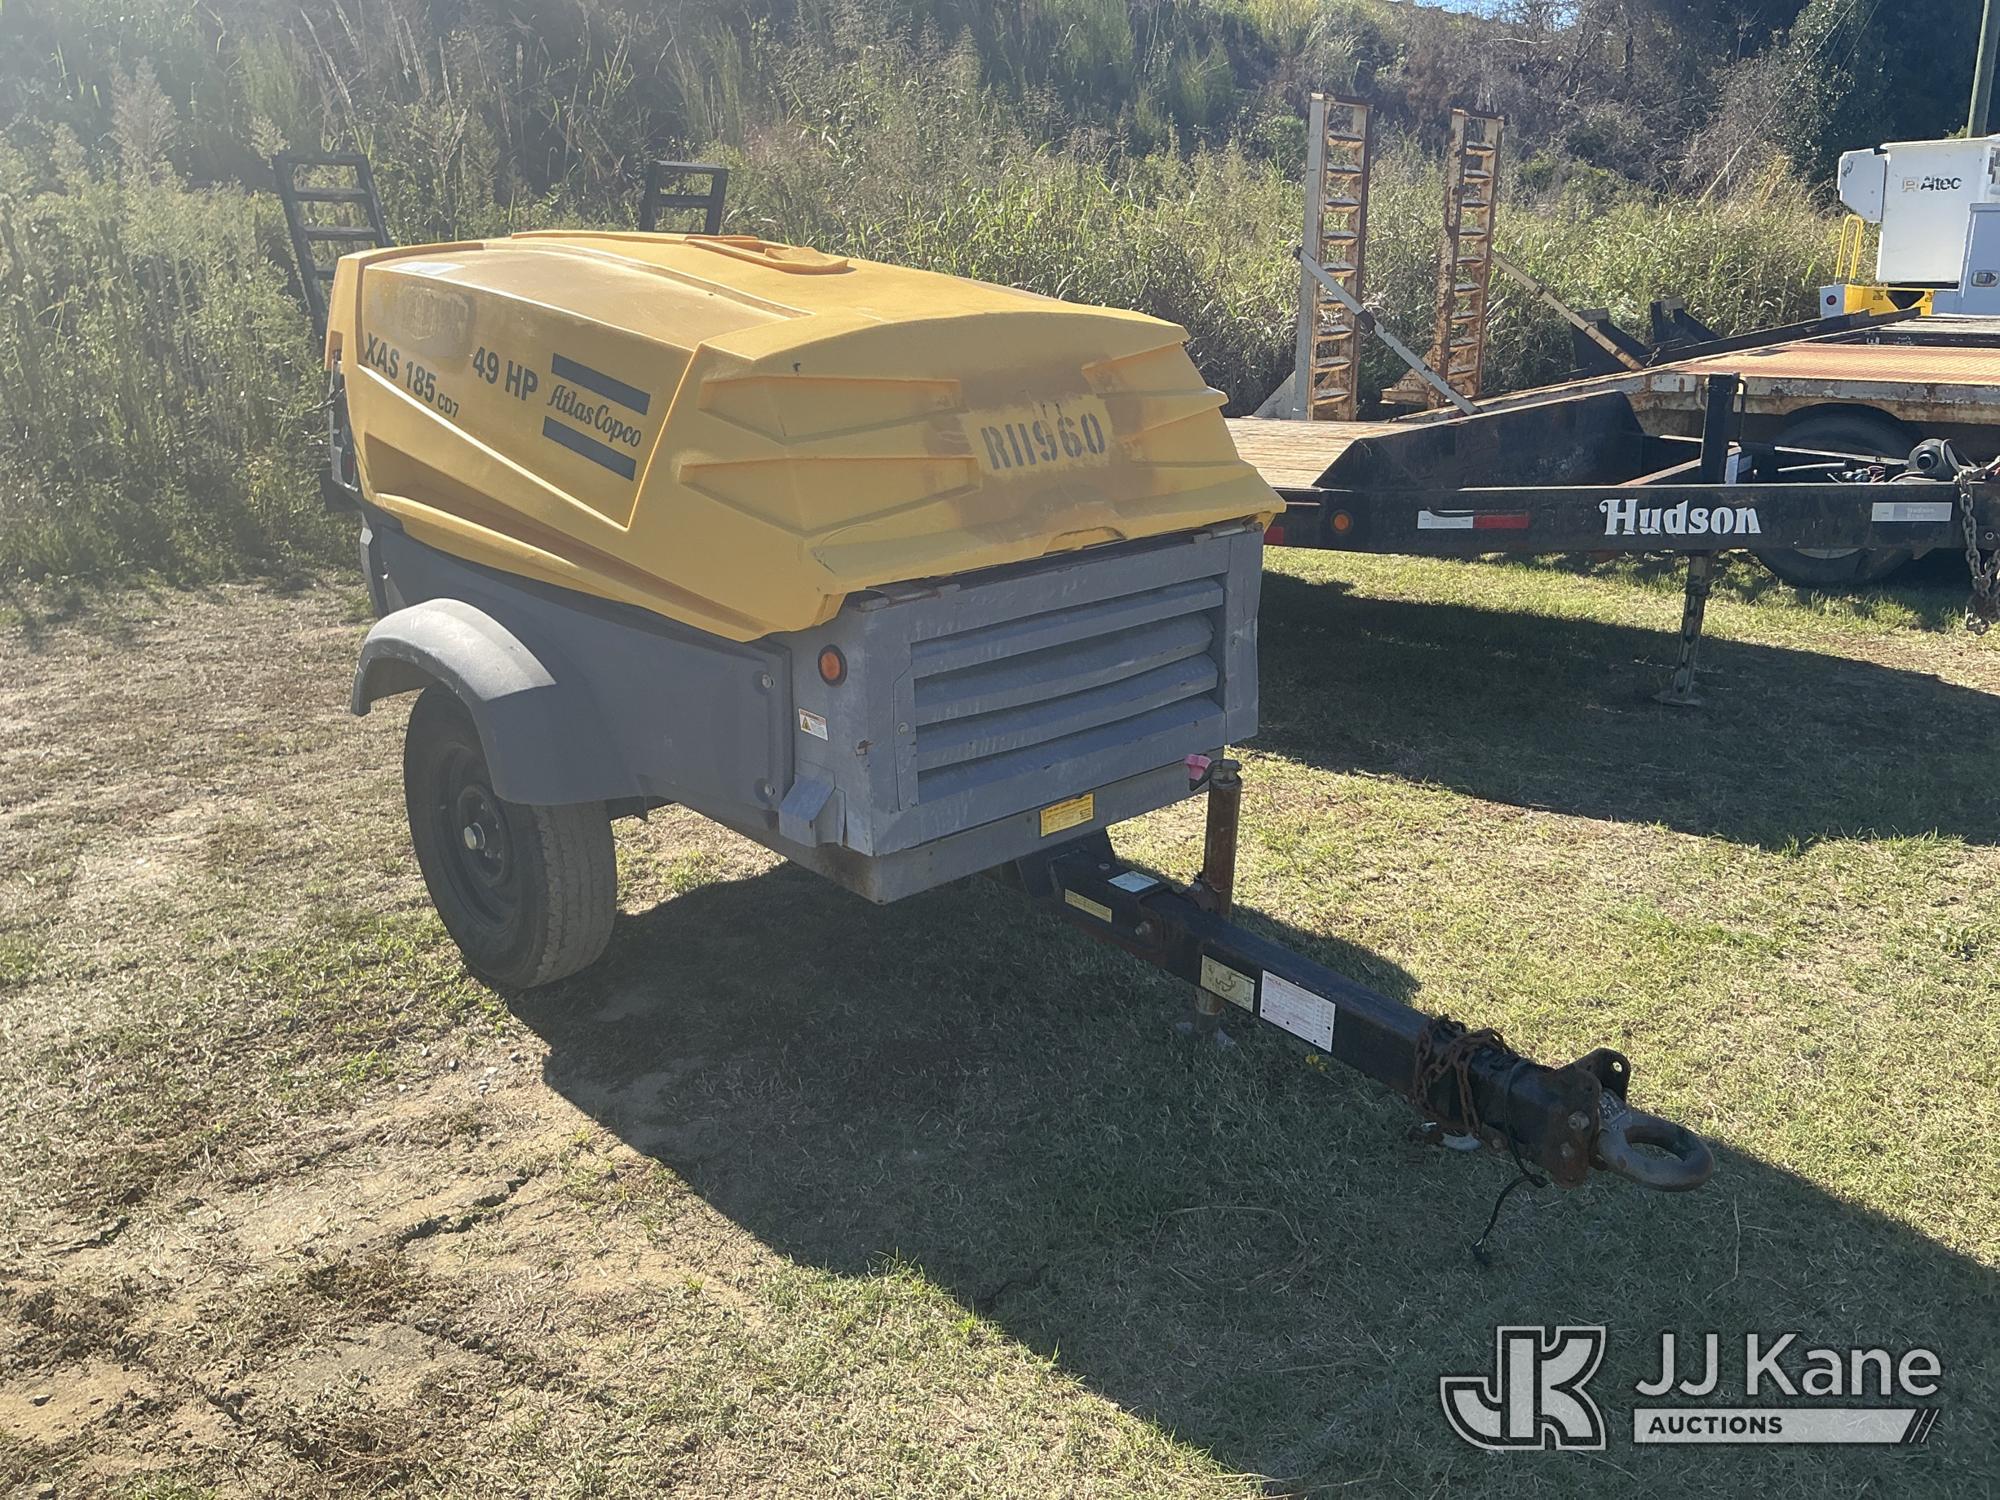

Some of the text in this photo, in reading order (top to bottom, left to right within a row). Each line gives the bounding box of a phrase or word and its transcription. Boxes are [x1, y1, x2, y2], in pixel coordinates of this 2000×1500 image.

[1920, 176, 1962, 191] Altec
[364, 331, 459, 418] XAS 185 CD7
[472, 346, 539, 400] 49 HP
[546, 384, 642, 448] Atlas Copco
[1598, 498, 1762, 536] Hudson
